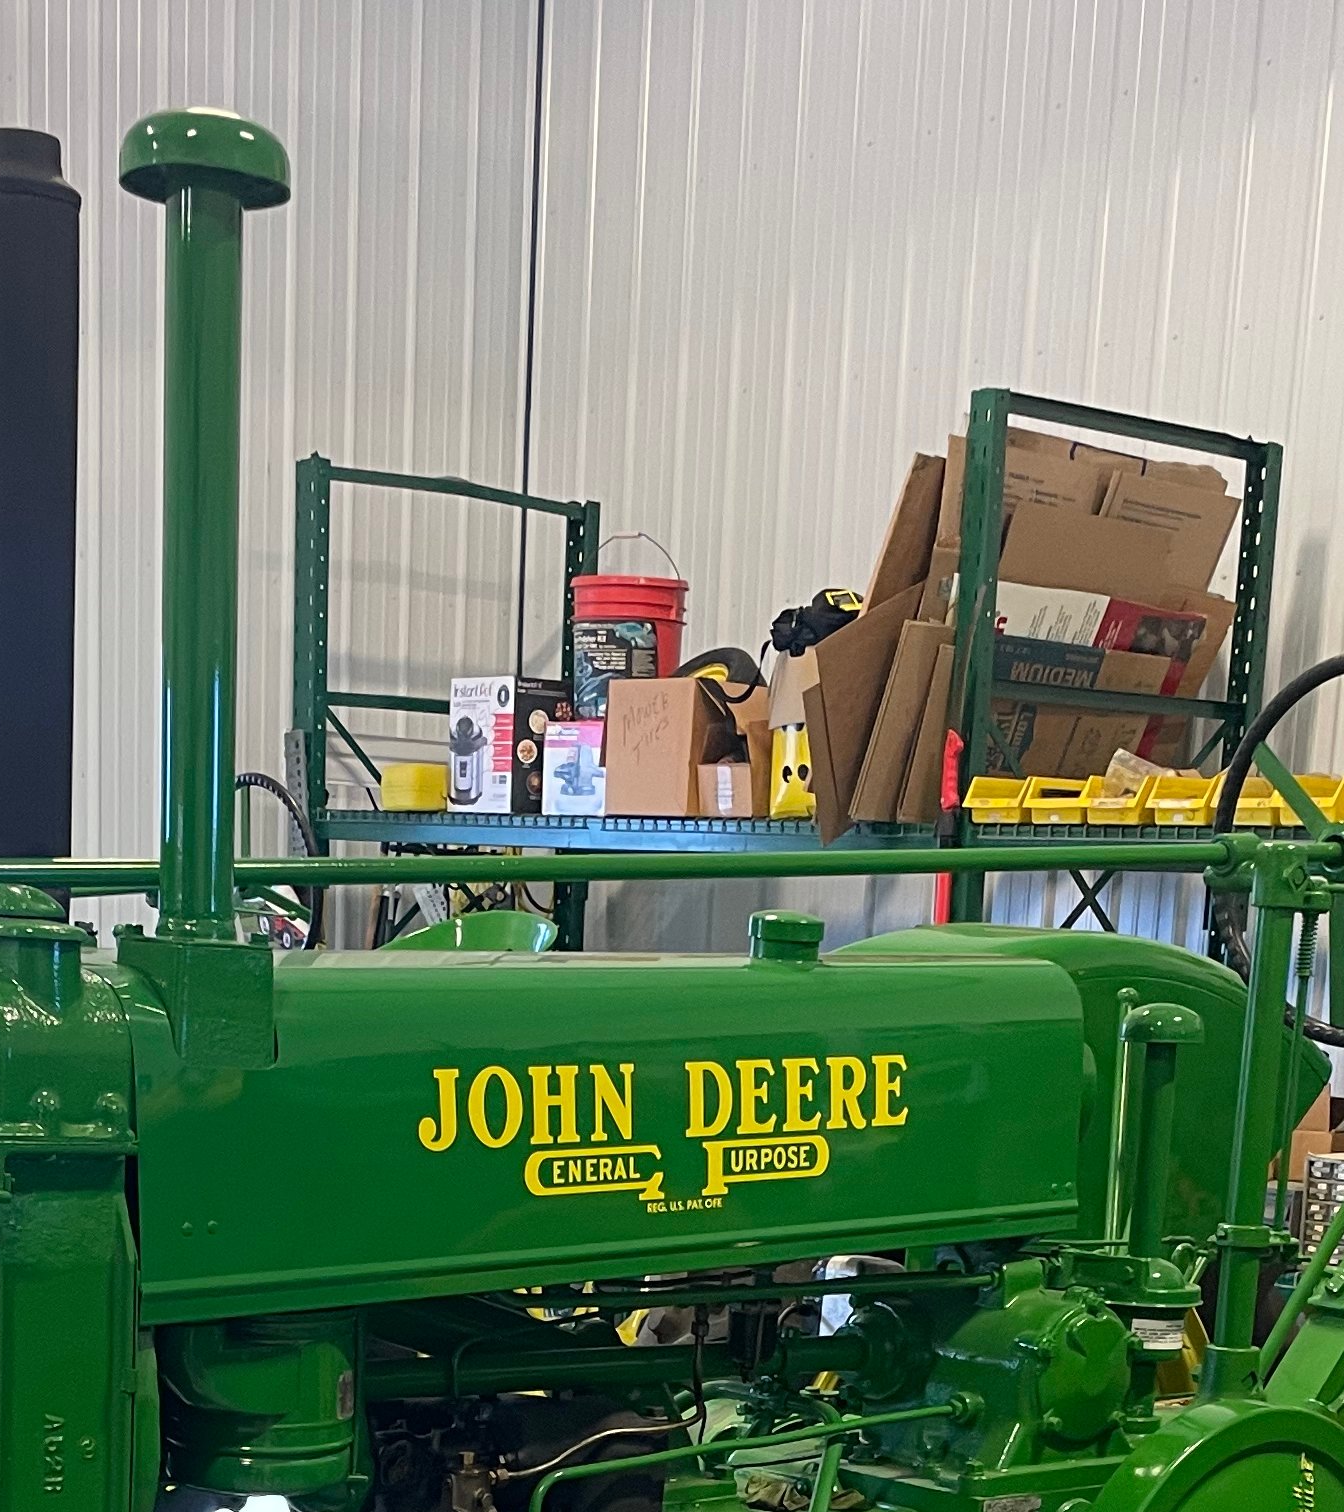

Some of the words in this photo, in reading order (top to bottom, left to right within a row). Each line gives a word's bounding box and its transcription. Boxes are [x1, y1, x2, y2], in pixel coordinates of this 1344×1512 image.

[1010, 660, 1095, 689] MEDIUM
[418, 1062, 635, 1152] JOHN
[684, 1054, 910, 1139] DEERE
